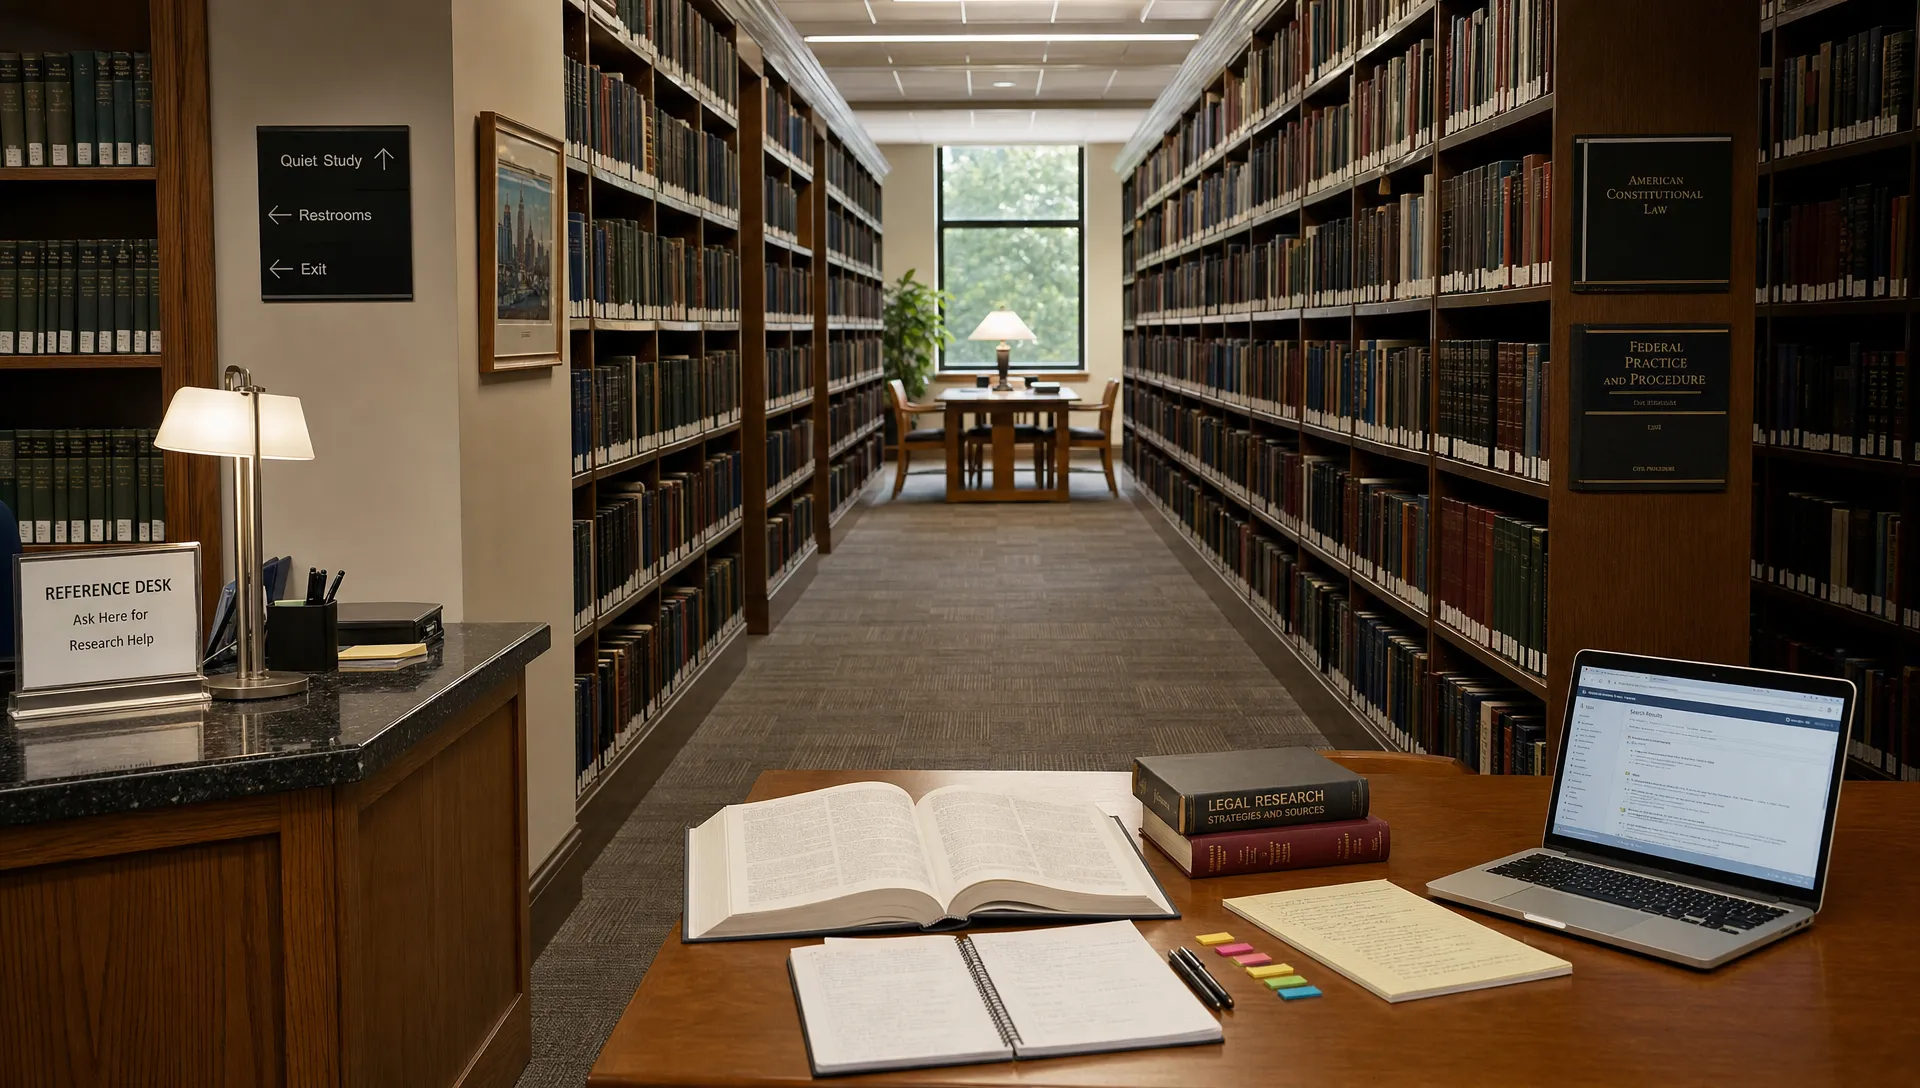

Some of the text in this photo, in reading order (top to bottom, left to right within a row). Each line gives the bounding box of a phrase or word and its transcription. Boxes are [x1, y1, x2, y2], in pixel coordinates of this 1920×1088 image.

[280, 154, 363, 170] Quiet Study
[1628, 175, 1684, 185] AMERICAN
[1606, 188, 1703, 199] CONSTITUTIONAL
[299, 209, 372, 222] Restrooms
[1643, 203, 1668, 215] LAW
[301, 263, 327, 276] Exit
[1629, 340, 1684, 353] FEDERAL
[1624, 356, 1688, 369] PRACTICE
[1603, 373, 1706, 386] AND PROCEDURE
[45, 578, 172, 601] REFERENCE DESK
[73, 608, 149, 626] Ask Here for
[69, 633, 154, 651] Research Help
[1208, 790, 1324, 811] LEGAL RESEARCH
[1208, 805, 1325, 825] STRATEGIES AND SOURCES
